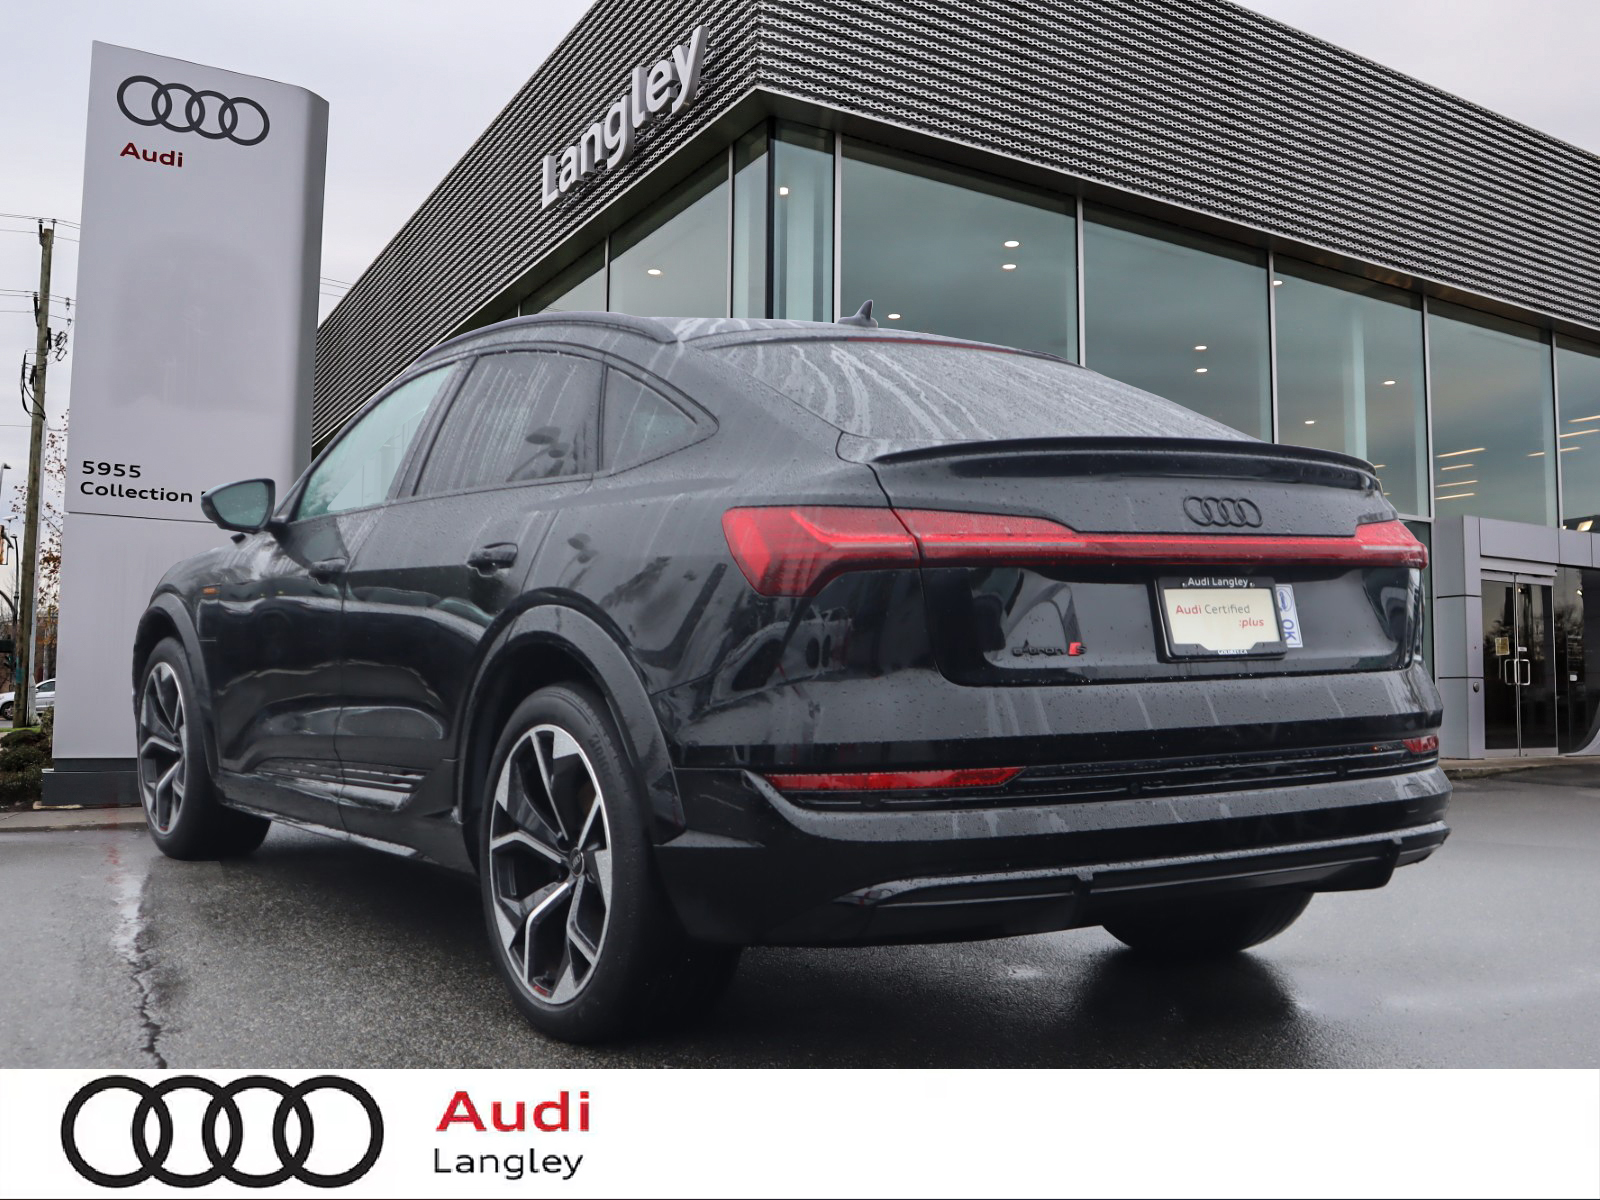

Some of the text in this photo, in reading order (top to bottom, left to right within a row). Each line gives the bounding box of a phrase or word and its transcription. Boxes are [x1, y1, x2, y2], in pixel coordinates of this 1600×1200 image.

[541, 25, 710, 209] Langley
[120, 142, 184, 168] Audi
[82, 460, 141, 478] 5955
[80, 481, 193, 503] Collection
[1187, 577, 1249, 588] Audi Langley
[1175, 604, 1250, 615] Audi Certified
